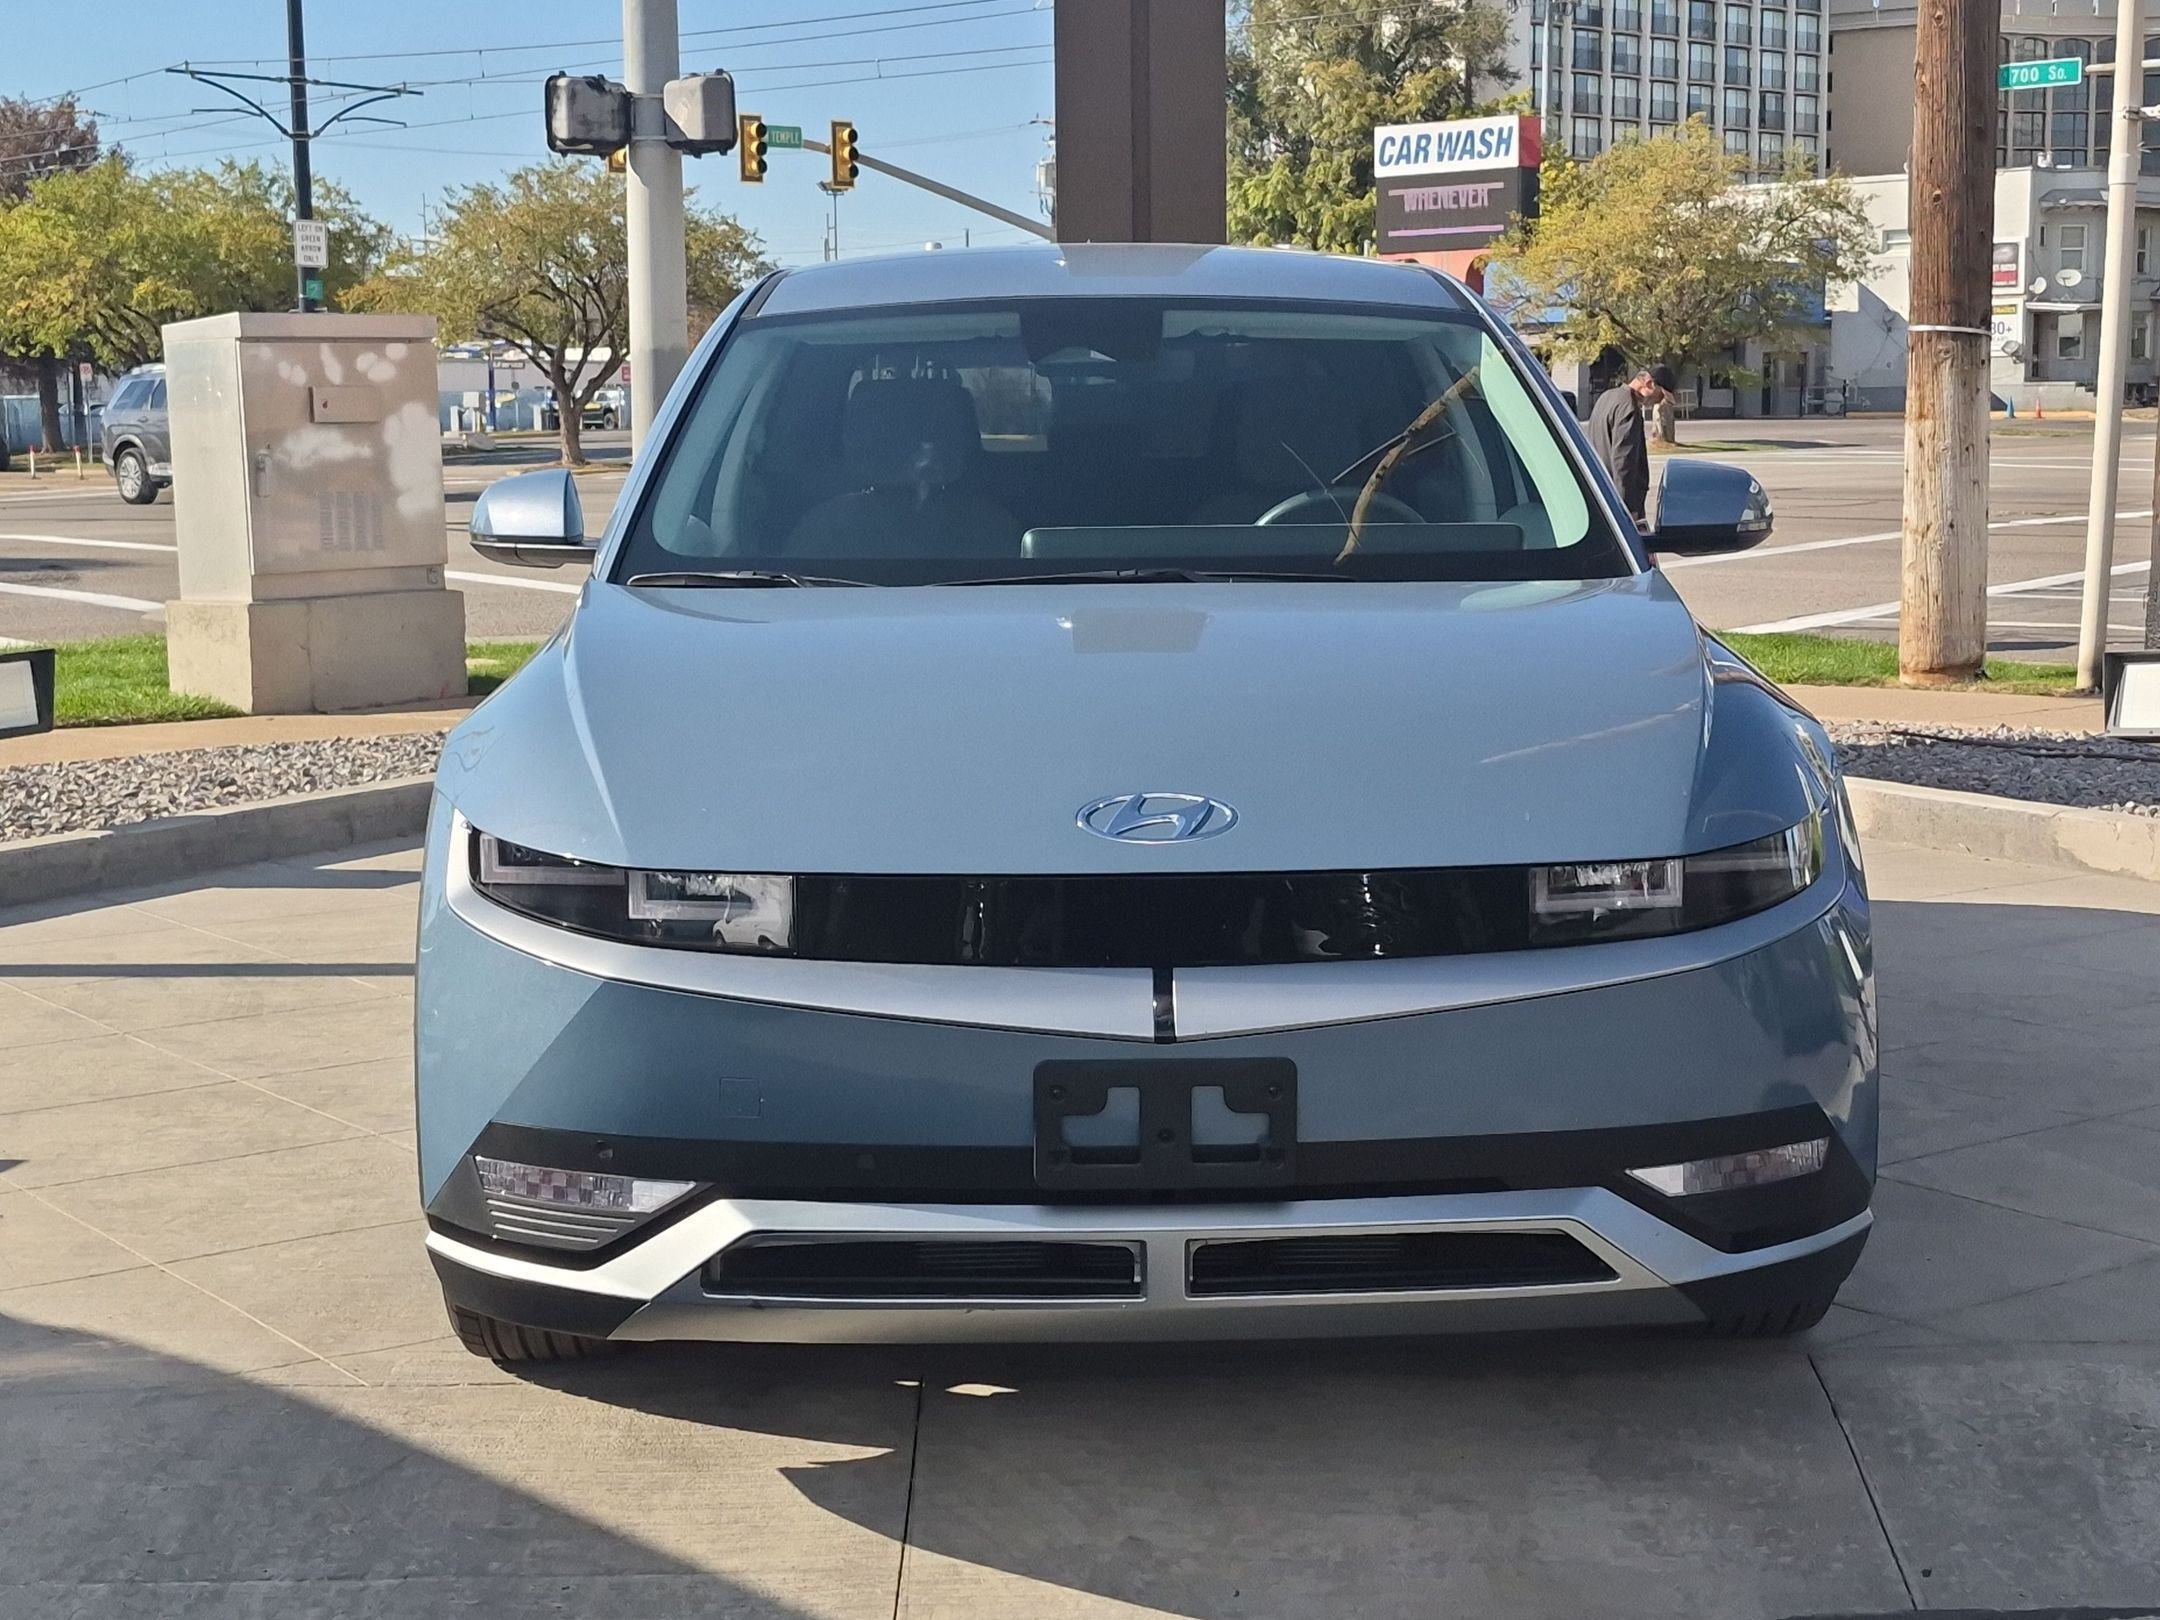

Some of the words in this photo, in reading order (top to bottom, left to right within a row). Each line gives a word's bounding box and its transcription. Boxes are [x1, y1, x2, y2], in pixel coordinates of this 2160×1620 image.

[2011, 67, 2039, 84] 700
[2048, 65, 2067, 81] So.
[771, 131, 800, 144] TEMPLE
[1378, 133, 1432, 167] CAR
[1437, 126, 1514, 162] WASH
